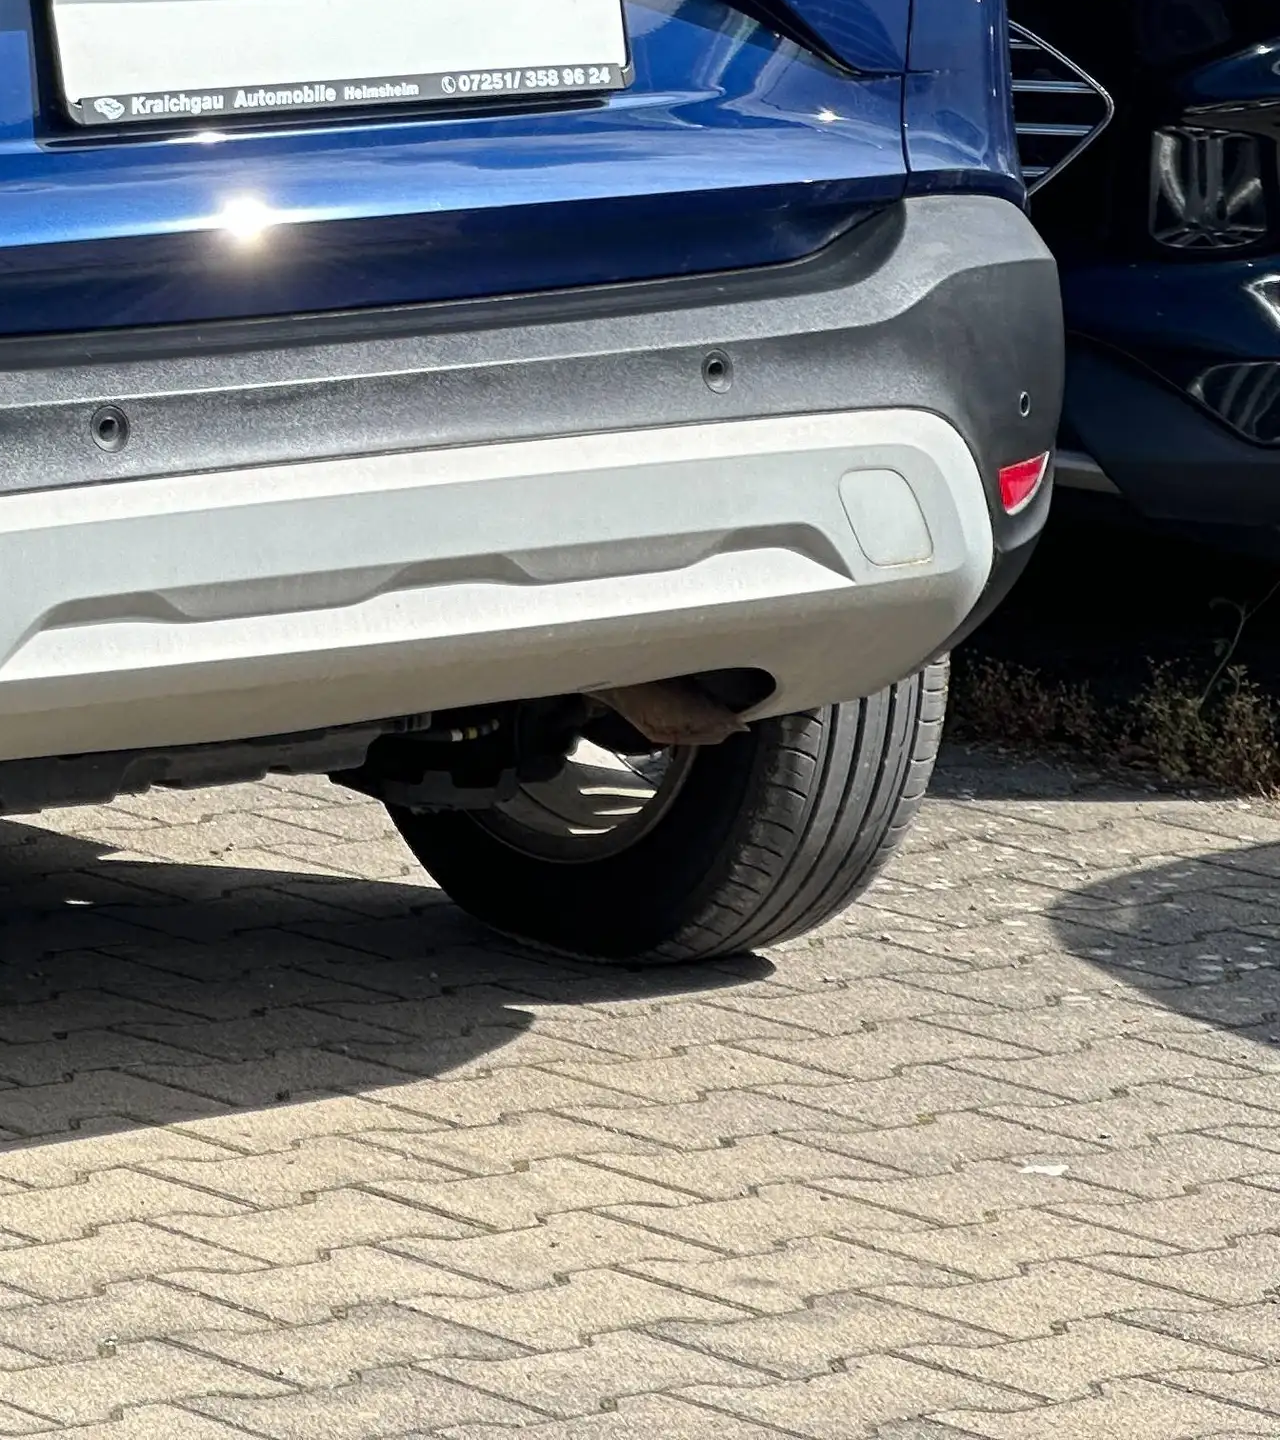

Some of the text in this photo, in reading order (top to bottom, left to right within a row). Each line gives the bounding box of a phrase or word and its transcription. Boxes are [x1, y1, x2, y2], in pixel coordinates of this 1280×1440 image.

[131, 95, 224, 115] Kraichgau
[234, 85, 336, 108] Automobile
[458, 71, 521, 92] 07251/
[525, 68, 559, 88] 358
[562, 68, 585, 85] 96
[589, 67, 611, 84] 24
